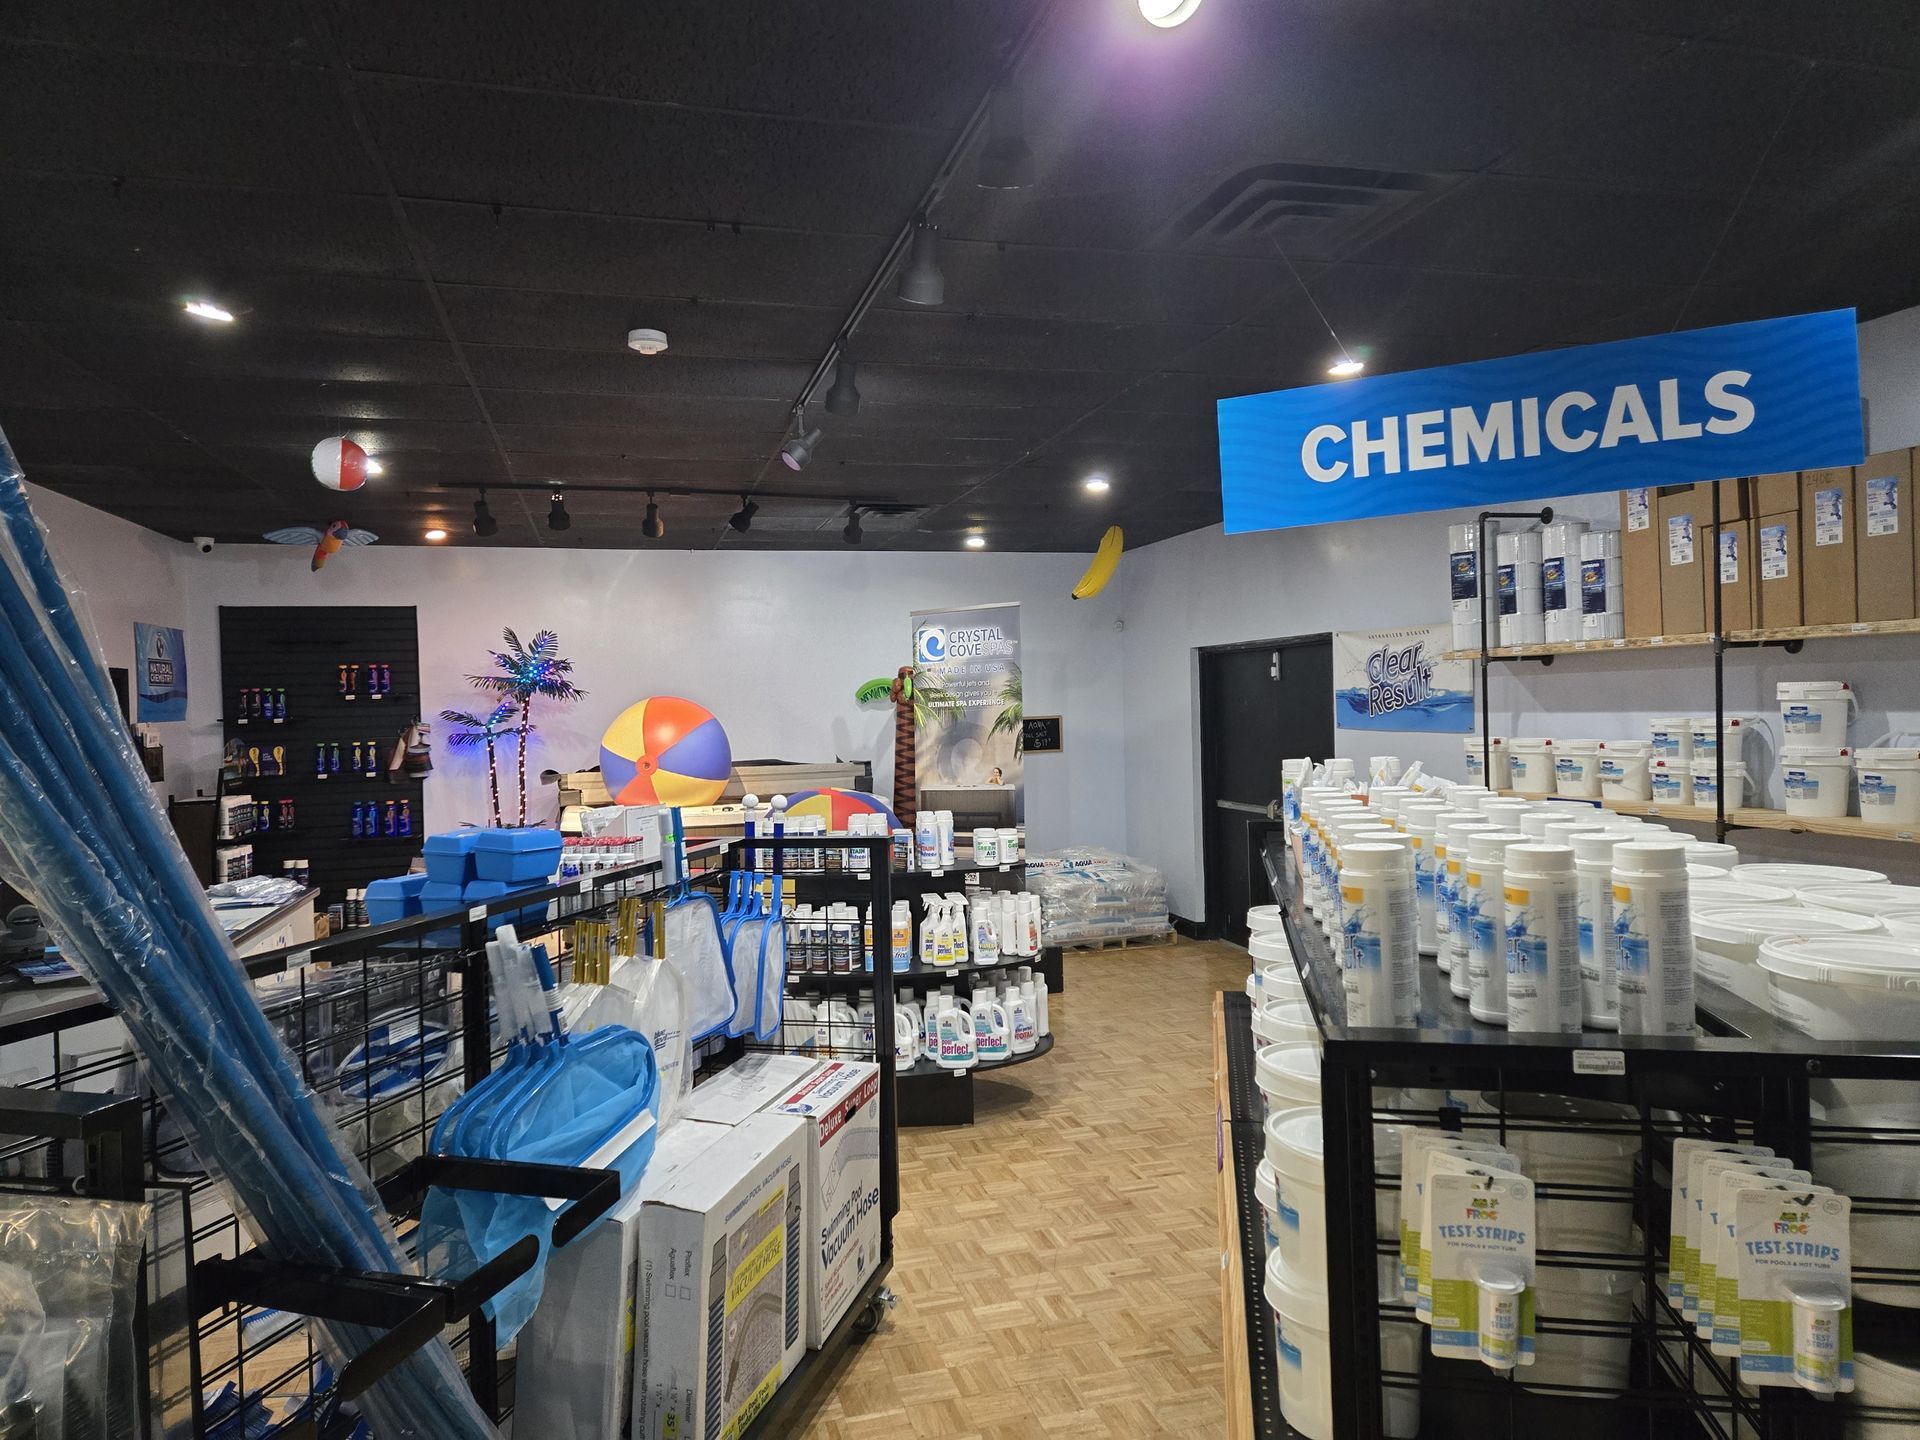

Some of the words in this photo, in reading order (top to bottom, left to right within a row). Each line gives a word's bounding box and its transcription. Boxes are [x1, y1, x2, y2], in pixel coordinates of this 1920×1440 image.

[1300, 369, 1756, 483] CHEMICALS
[949, 628, 1003, 644] CRYSTAL
[150, 662, 172, 674] NATURAL
[940, 666, 966, 674] MADE
[986, 664, 1005, 672] USA
[1366, 641, 1424, 684] Clear
[150, 673, 173, 682] CHEMISTRY
[1368, 664, 1433, 718] Result
[968, 699, 1004, 707] EXPERIENCE
[942, 1044, 968, 1055] perfect
[976, 1036, 1002, 1046] perfect
[820, 1110, 842, 1140] Deluxe
[864, 1078, 878, 1098] Loop
[762, 1170, 780, 1188] VACUUM
[780, 1155, 792, 1173] HOSE
[822, 1201, 850, 1246] Swimming
[850, 1180, 863, 1209] Pool
[1466, 1208, 1498, 1220] FROG
[822, 1216, 856, 1270] Vacuum
[856, 1187, 879, 1225] Hose
[1774, 1222, 1809, 1235] FROG
[644, 1260, 652, 1270] (1)
[684, 1250, 692, 1277] Proflex
[730, 1264, 762, 1302] VACUUM
[762, 1242, 782, 1270] HOSE
[644, 1272, 652, 1310] Swimming
[1806, 1340, 1834, 1348] STRIPS
[638, 1394, 648, 1424] rotating
[684, 1388, 694, 1422] Diameter
[738, 1409, 748, 1425] Best
